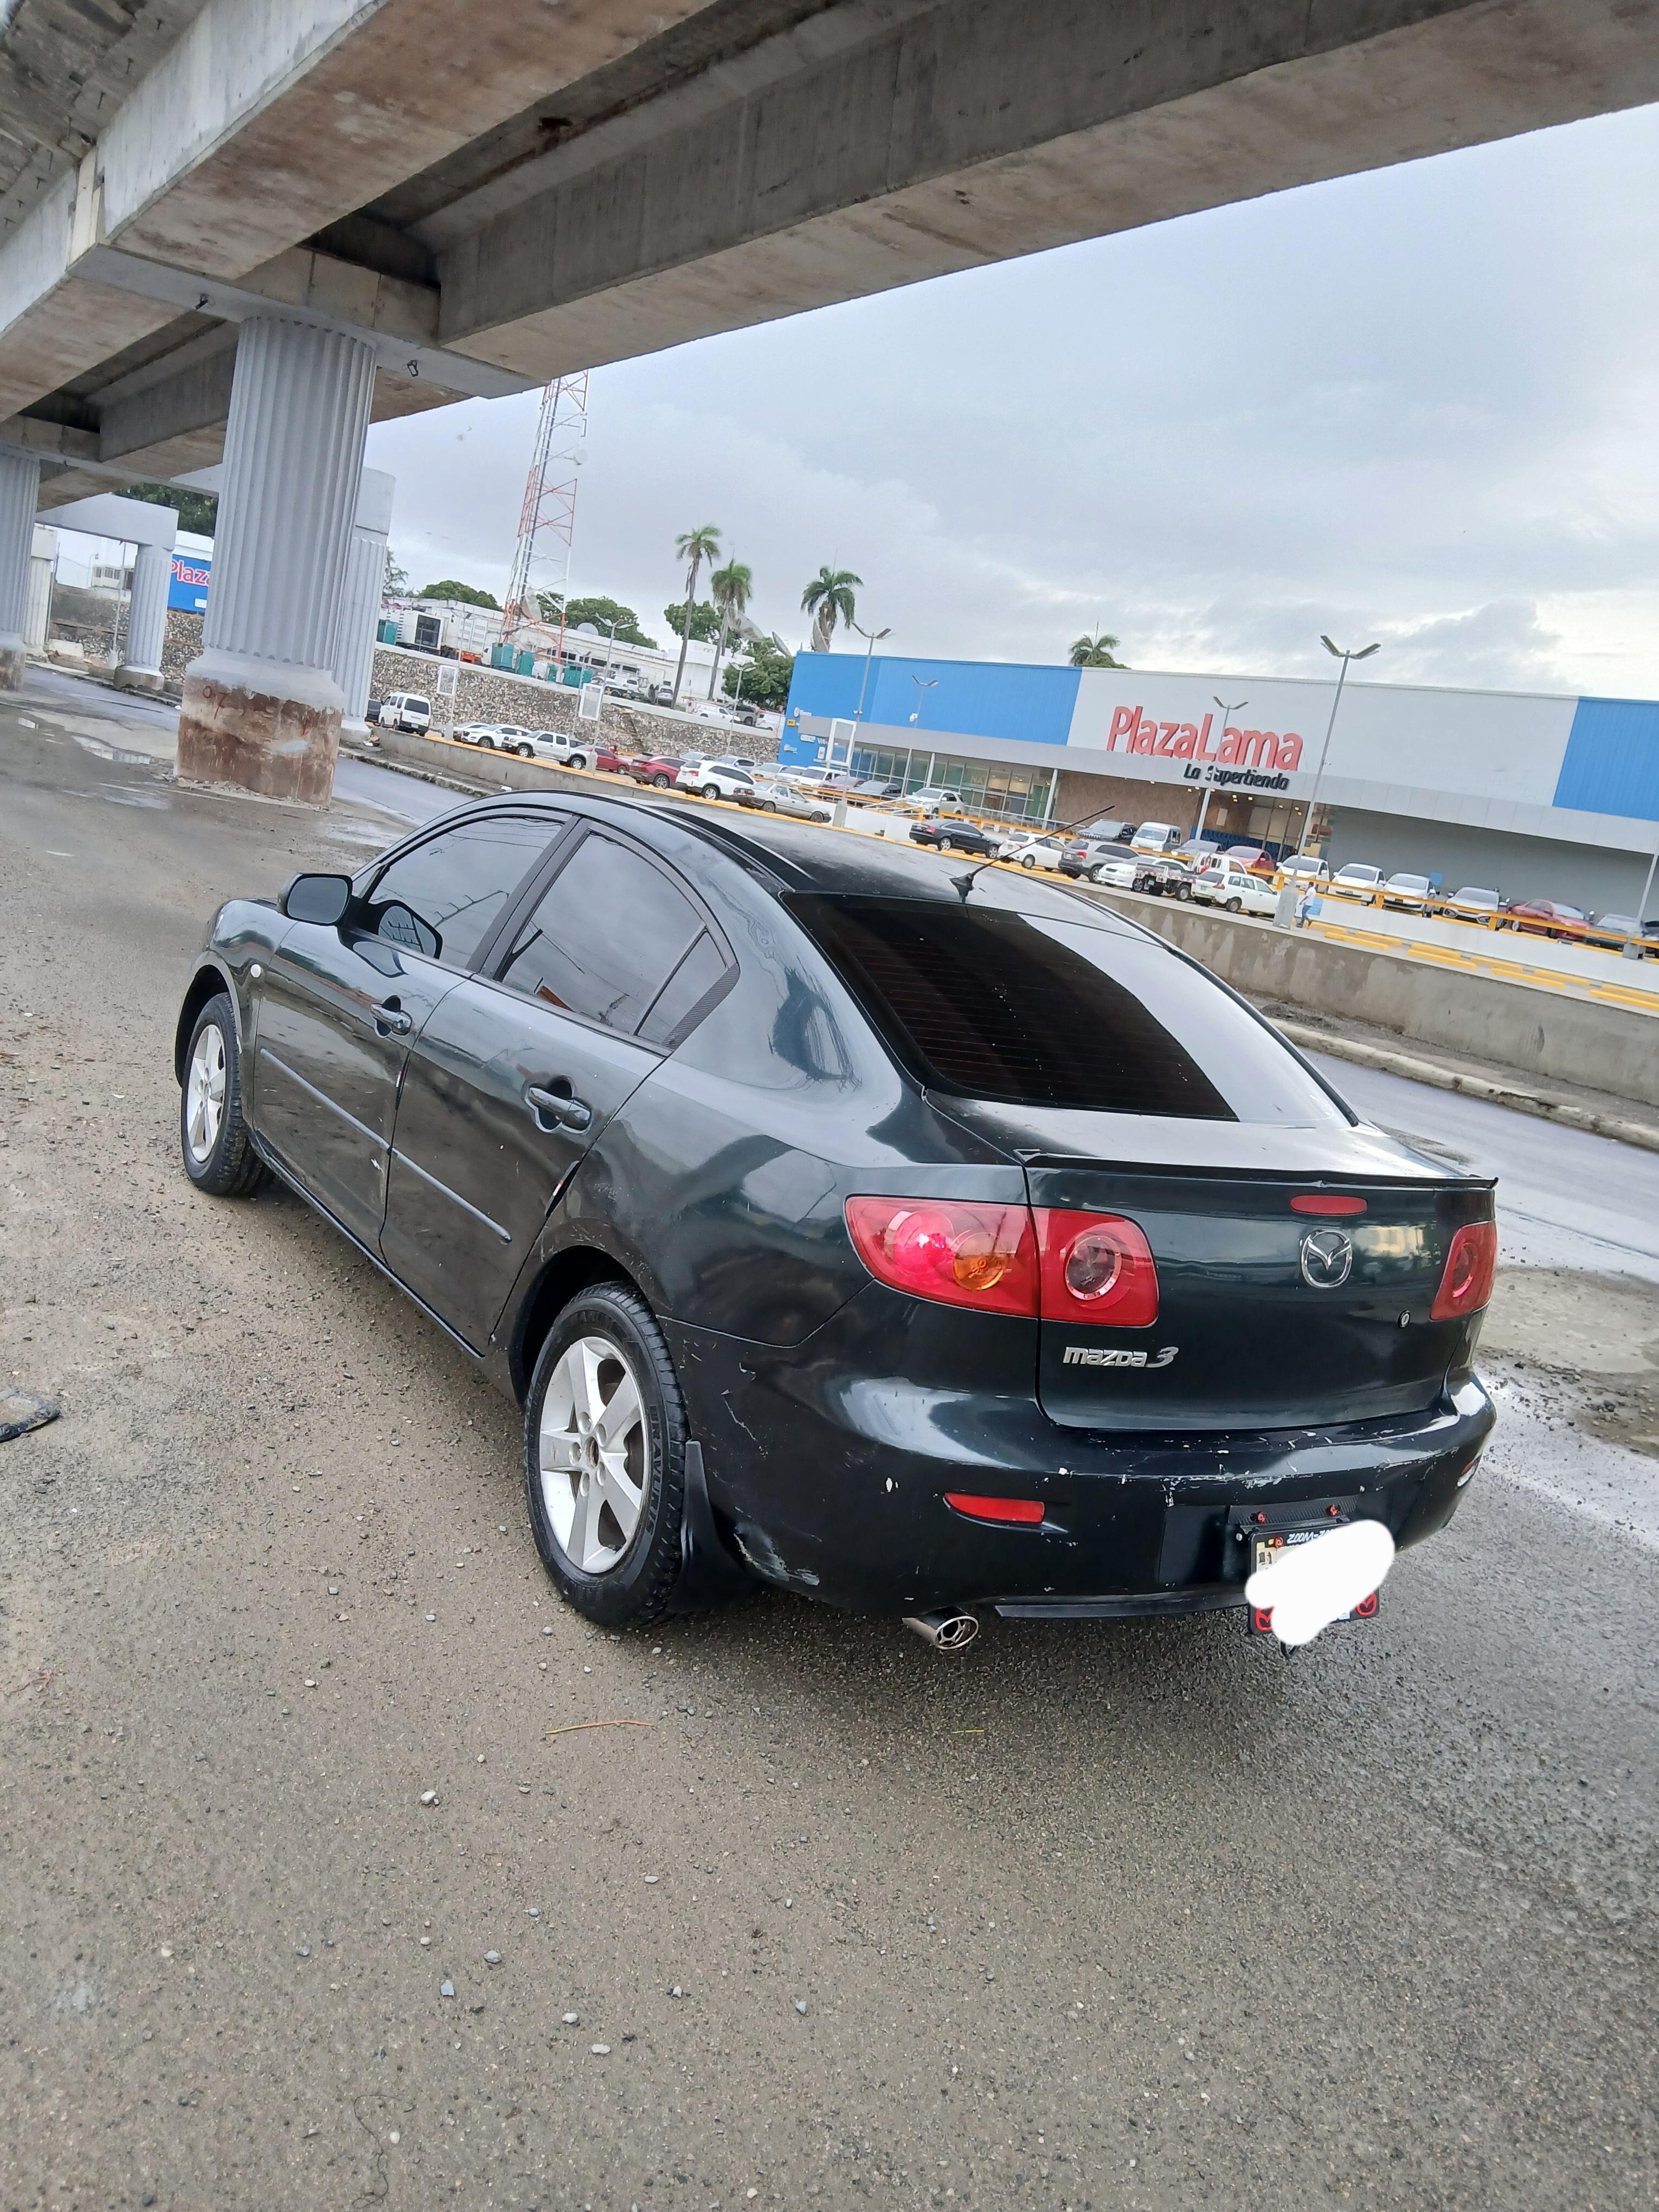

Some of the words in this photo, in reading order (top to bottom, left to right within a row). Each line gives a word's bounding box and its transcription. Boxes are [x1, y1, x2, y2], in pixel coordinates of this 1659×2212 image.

[1184, 763, 1202, 780] La
[1205, 765, 1290, 790] Supertienda
[1146, 1346, 1179, 1368] 3
